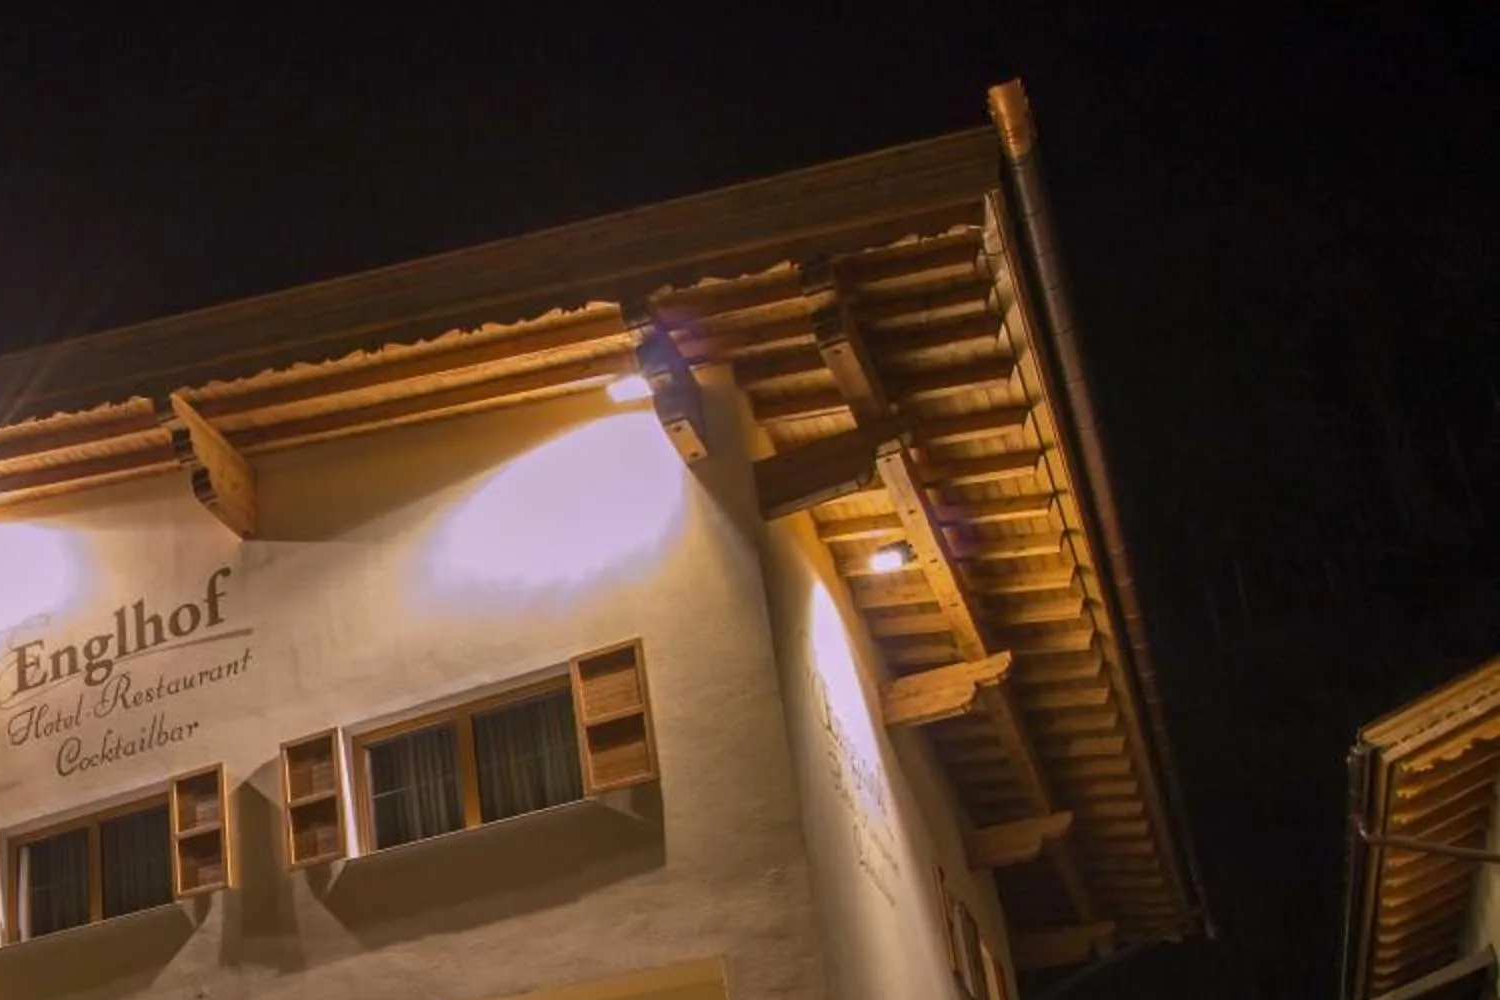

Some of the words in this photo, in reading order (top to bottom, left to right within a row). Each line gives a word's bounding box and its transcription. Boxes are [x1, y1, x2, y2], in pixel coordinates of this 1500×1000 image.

[3, 567, 232, 696] Englhof
[7, 693, 83, 746] Hotel
[94, 648, 252, 718] Restaurant
[56, 713, 200, 777] Cocktailbar
